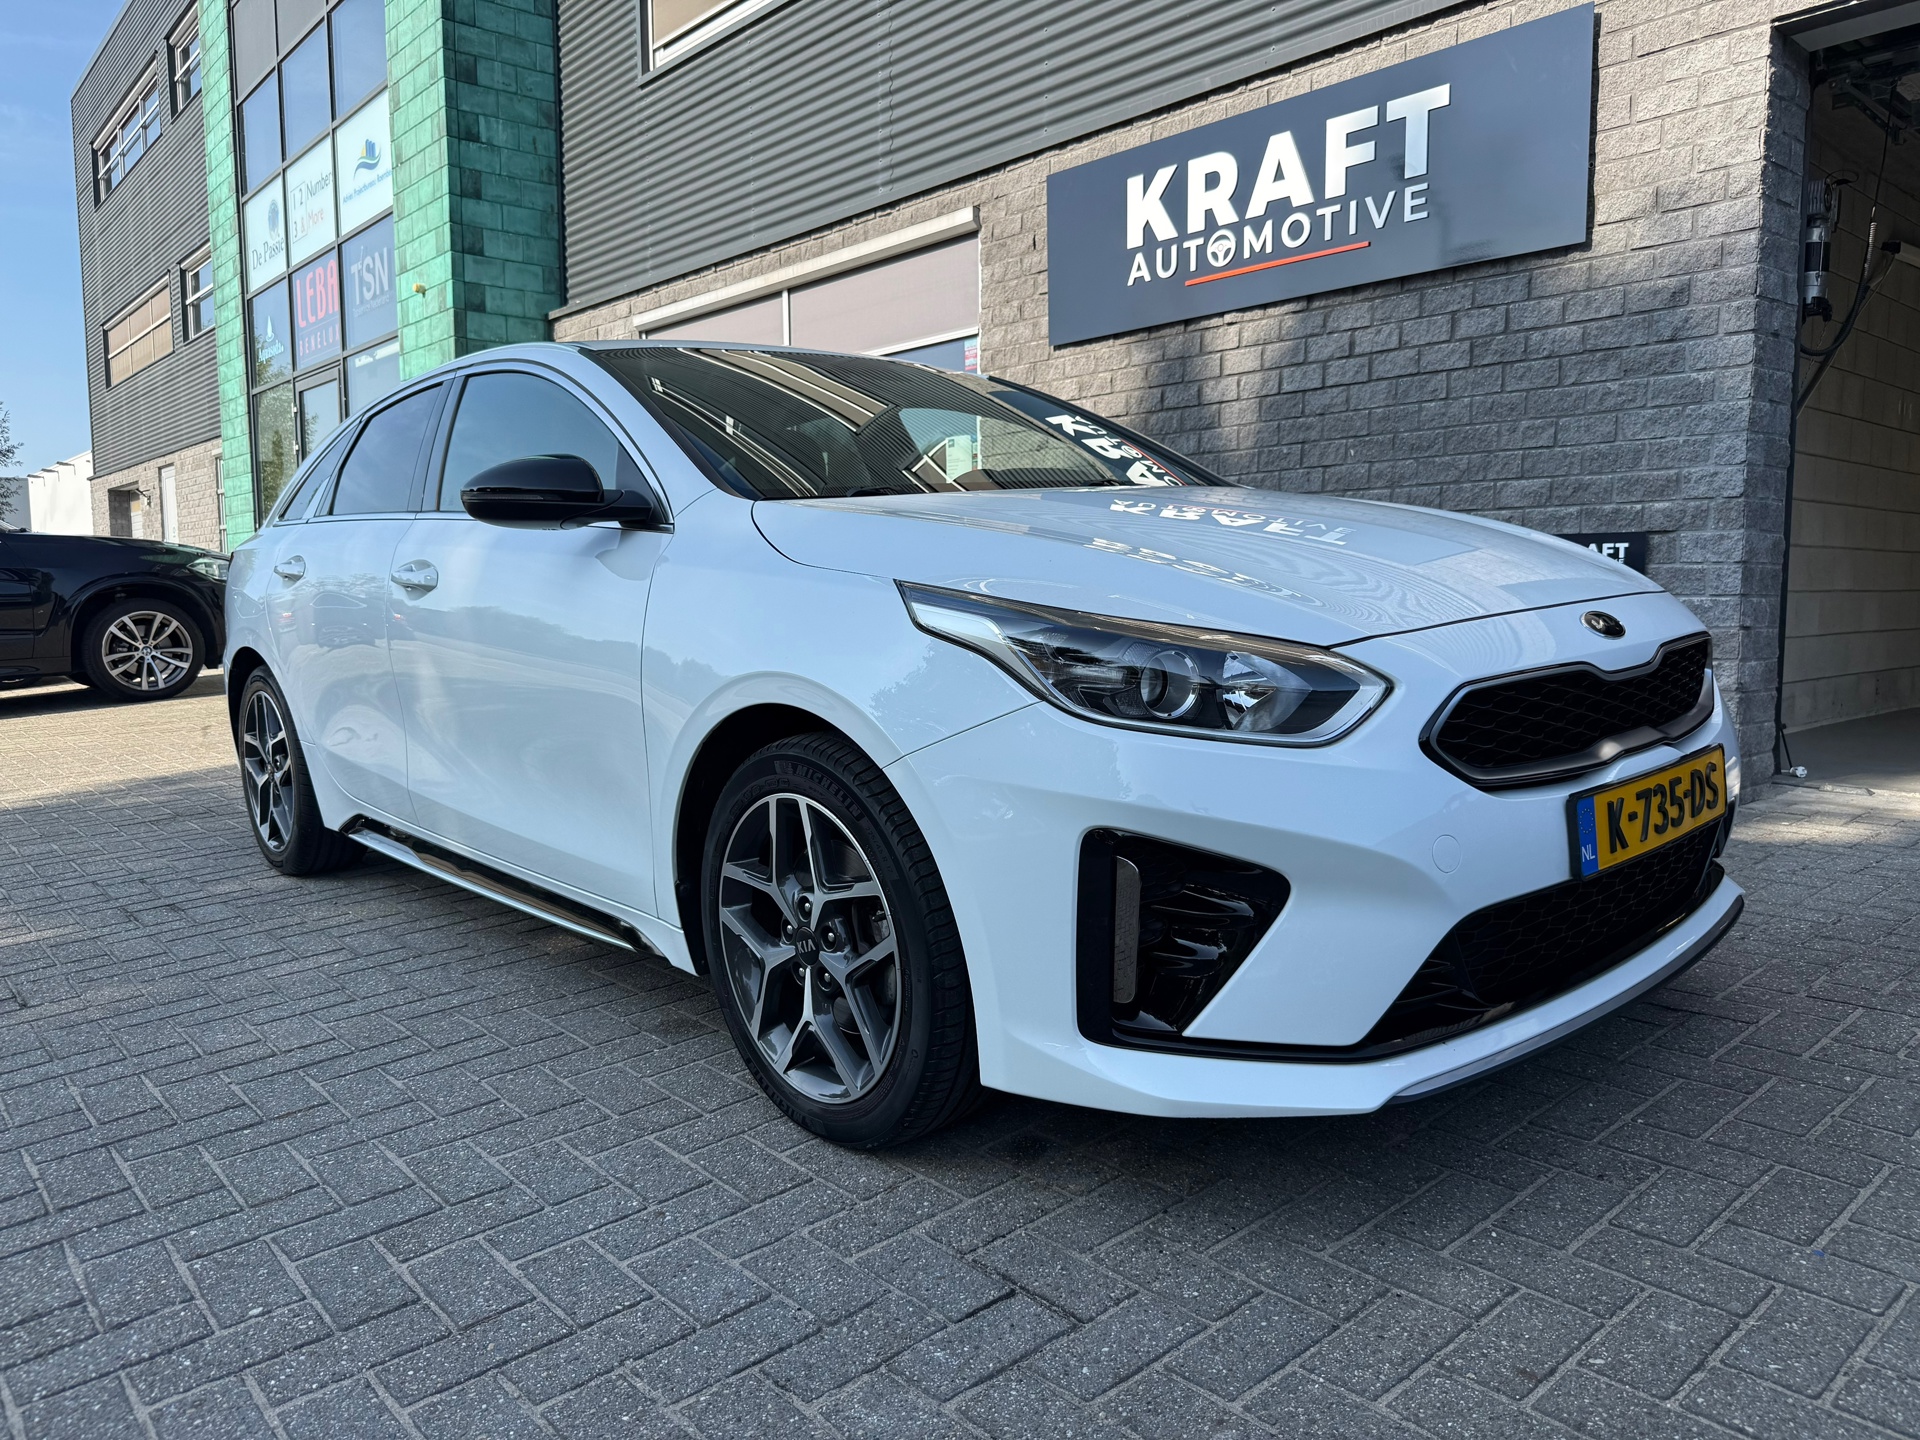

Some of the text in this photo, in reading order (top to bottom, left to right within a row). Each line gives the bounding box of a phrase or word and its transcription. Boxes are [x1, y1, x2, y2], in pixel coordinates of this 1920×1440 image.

[1126, 82, 1450, 250] KRAFT
[306, 171, 333, 201] Number
[1127, 182, 1430, 286] AUTOMOTIVE
[251, 249, 262, 271] De
[350, 247, 389, 306] TSN
[299, 322, 340, 357] BENELUX
[1588, 542, 1629, 559] AFT
[795, 764, 863, 819] MICHELIN
[1607, 762, 1720, 855] K-735-DS
[1581, 845, 1596, 863] NL
[796, 938, 816, 954] KIA
